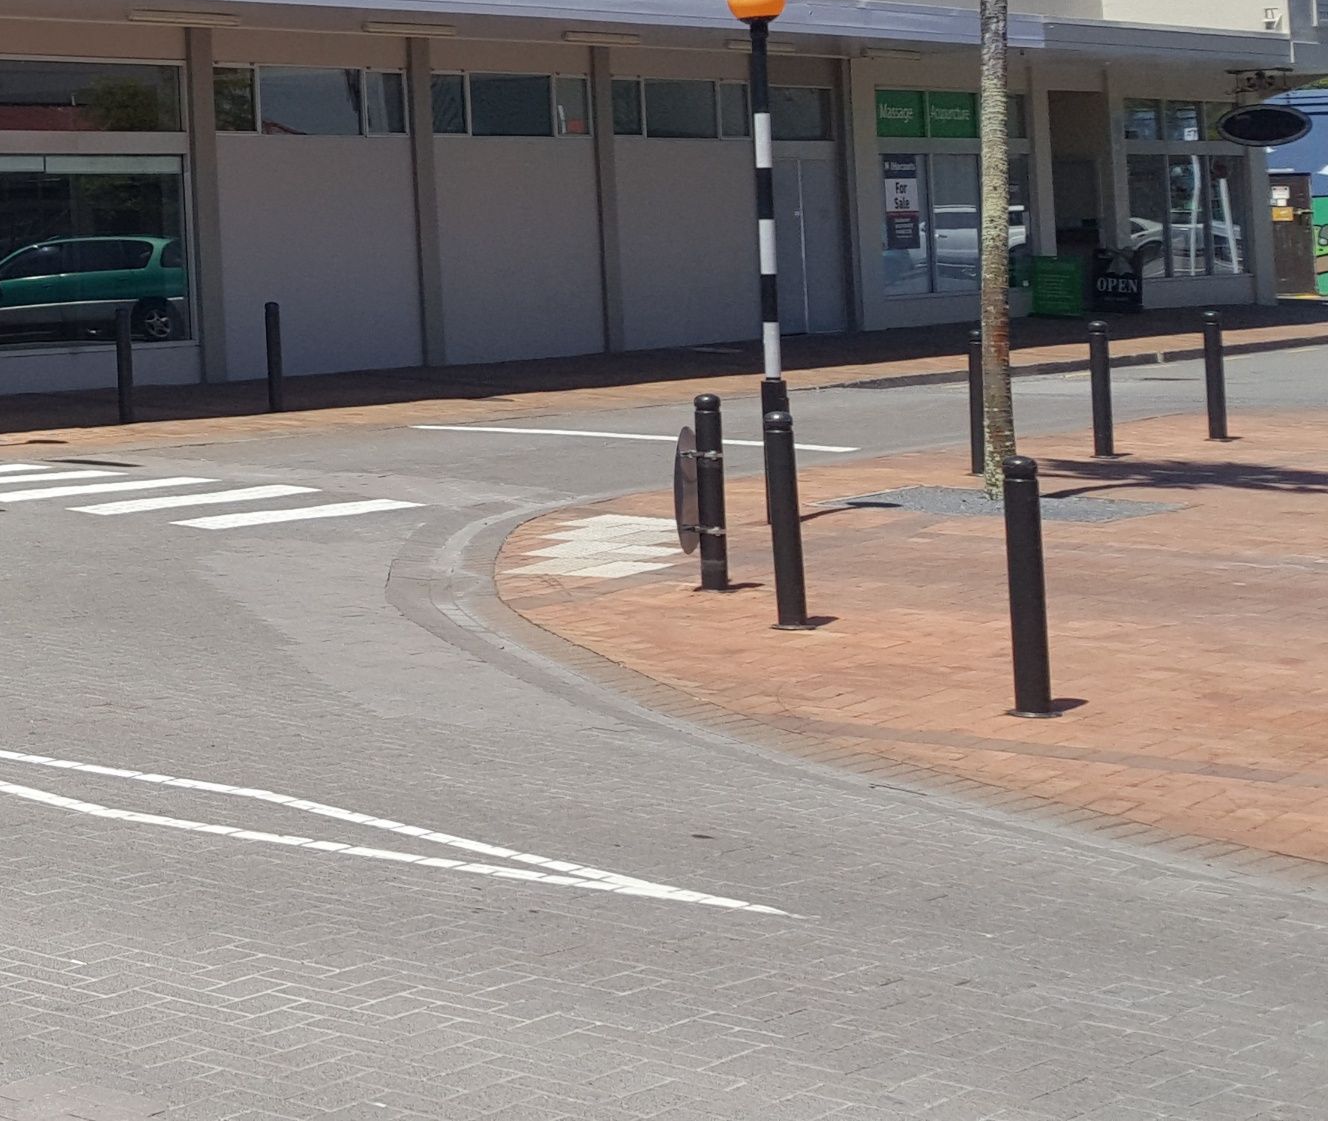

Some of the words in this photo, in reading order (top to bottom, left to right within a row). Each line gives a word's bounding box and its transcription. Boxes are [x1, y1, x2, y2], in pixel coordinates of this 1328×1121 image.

[879, 103, 913, 123] Massage
[895, 181, 907, 195] For
[894, 197, 910, 209] Sale
[1096, 277, 1138, 293] OPEN
